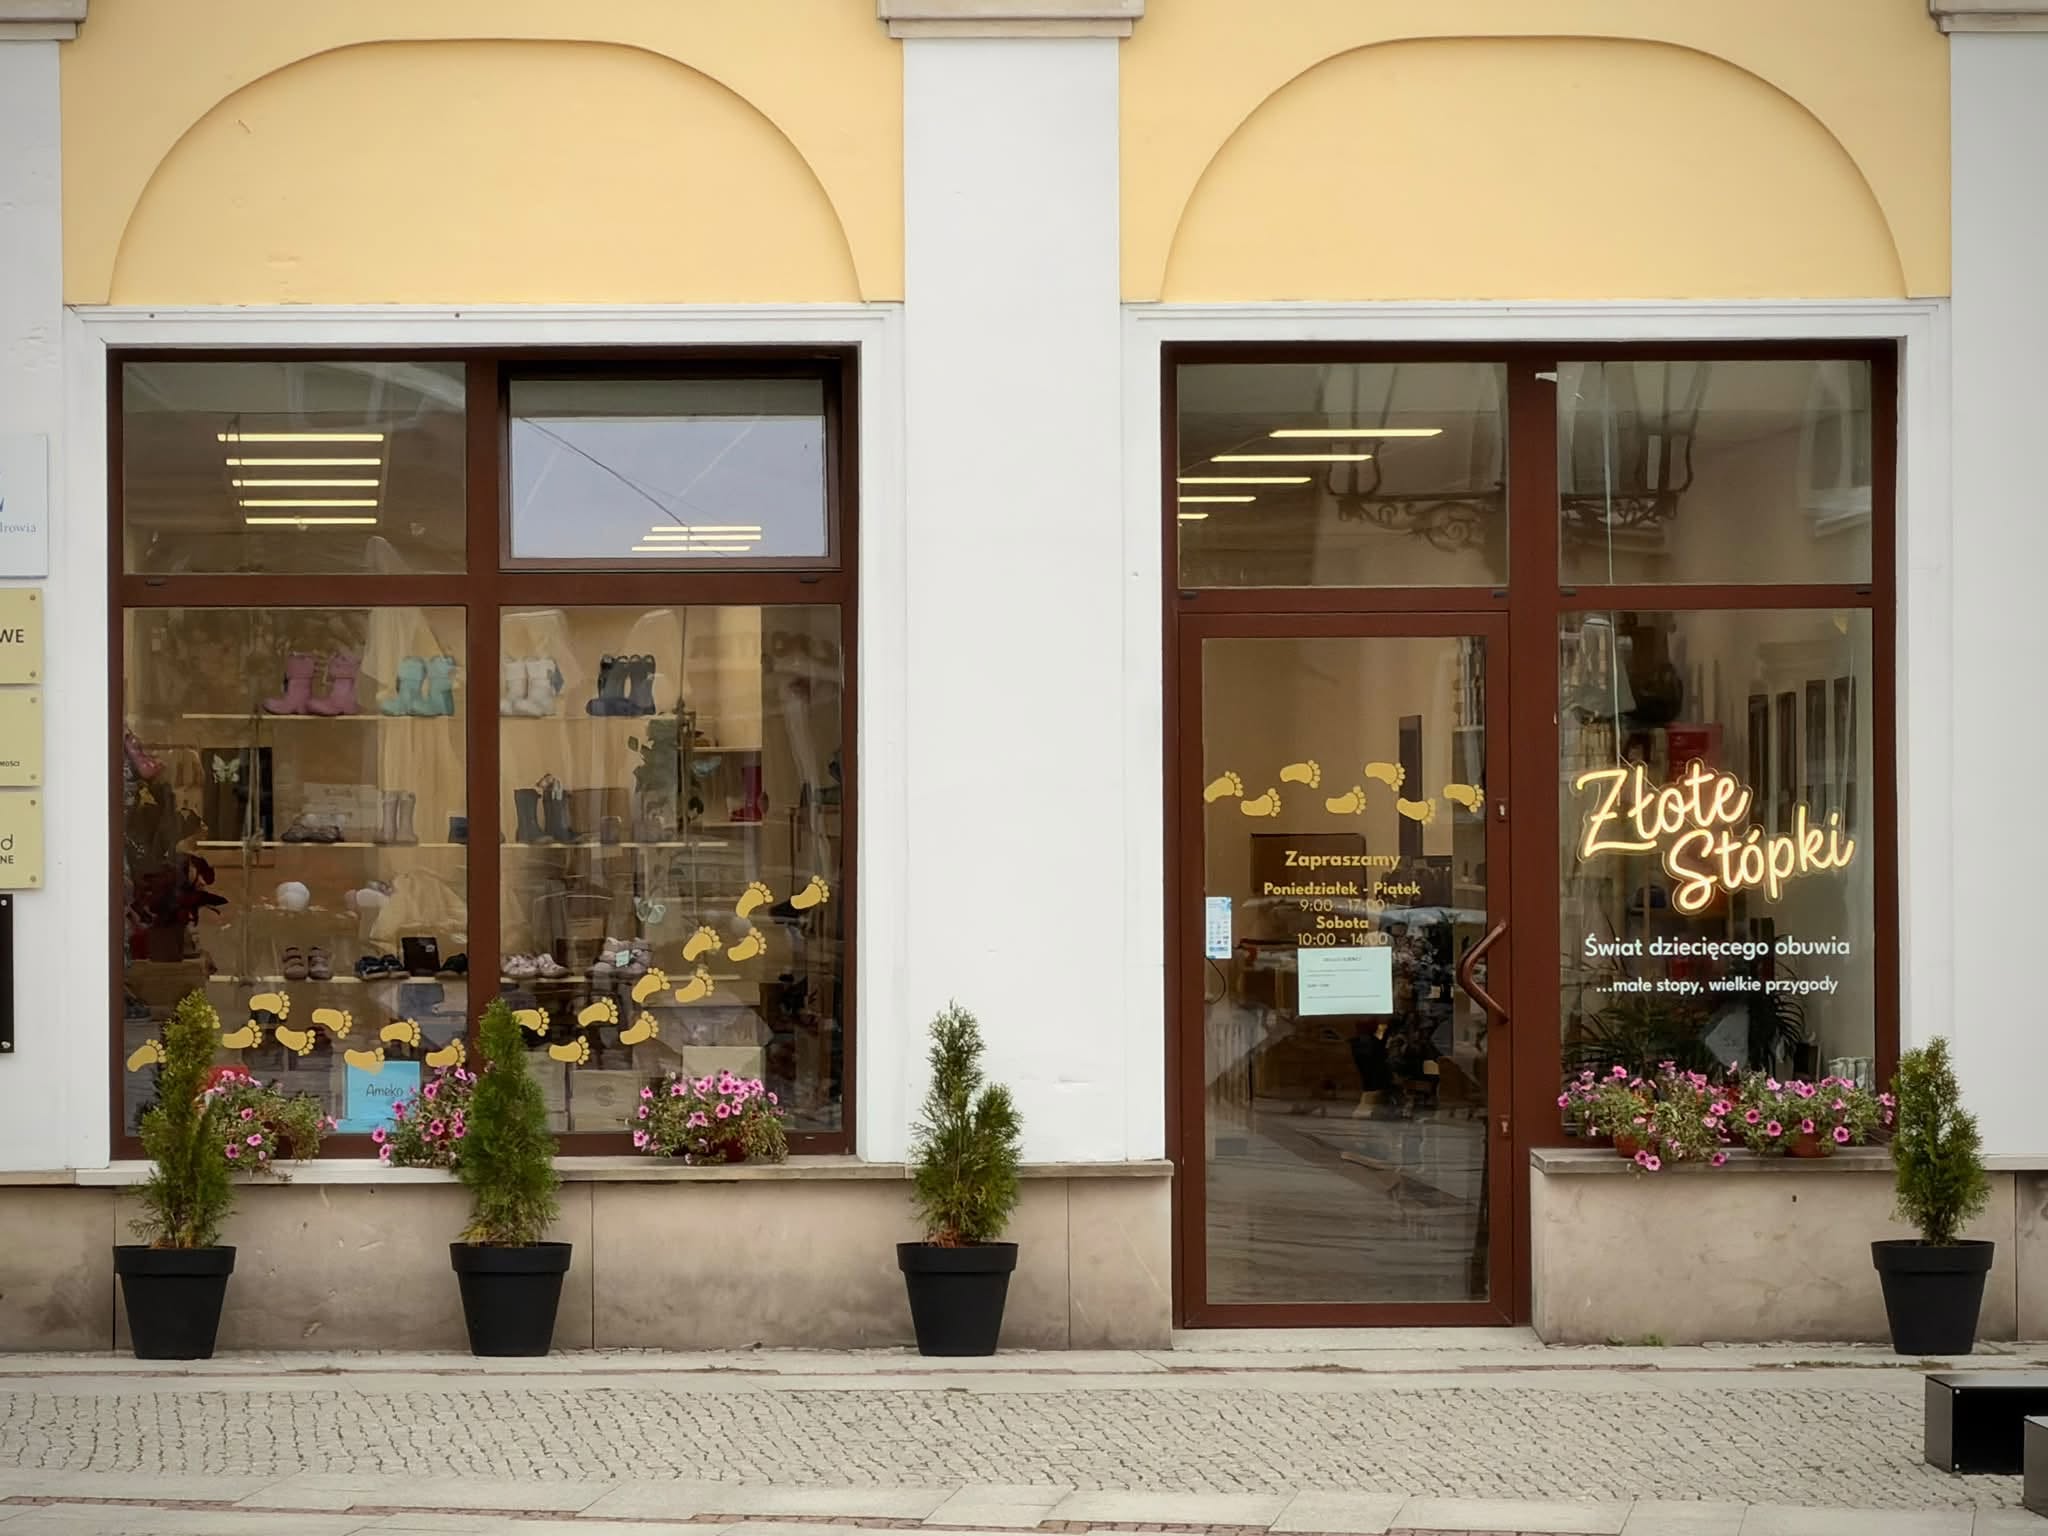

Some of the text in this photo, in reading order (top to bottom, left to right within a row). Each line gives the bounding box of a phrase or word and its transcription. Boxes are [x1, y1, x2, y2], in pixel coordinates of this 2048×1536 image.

[1577, 762, 1749, 857] Złote
[1285, 850, 1401, 870] Zapraszamy
[1669, 804, 1855, 910] Stópki
[1264, 882, 1359, 896] Poniedziałek
[1374, 882, 1421, 898] Piątek
[1300, 899, 1333, 912] 9:00
[1348, 899, 1385, 912] 17:00
[1316, 916, 1369, 929] Sobota
[1298, 933, 1336, 946] 10:00
[1351, 933, 1388, 946] 14:00
[1584, 934, 1851, 961] Świat dziecięcego obuwia
[1656, 979, 1704, 995] stopy,
[1709, 977, 1761, 991] wielkie
[1765, 977, 1838, 995] przygody
